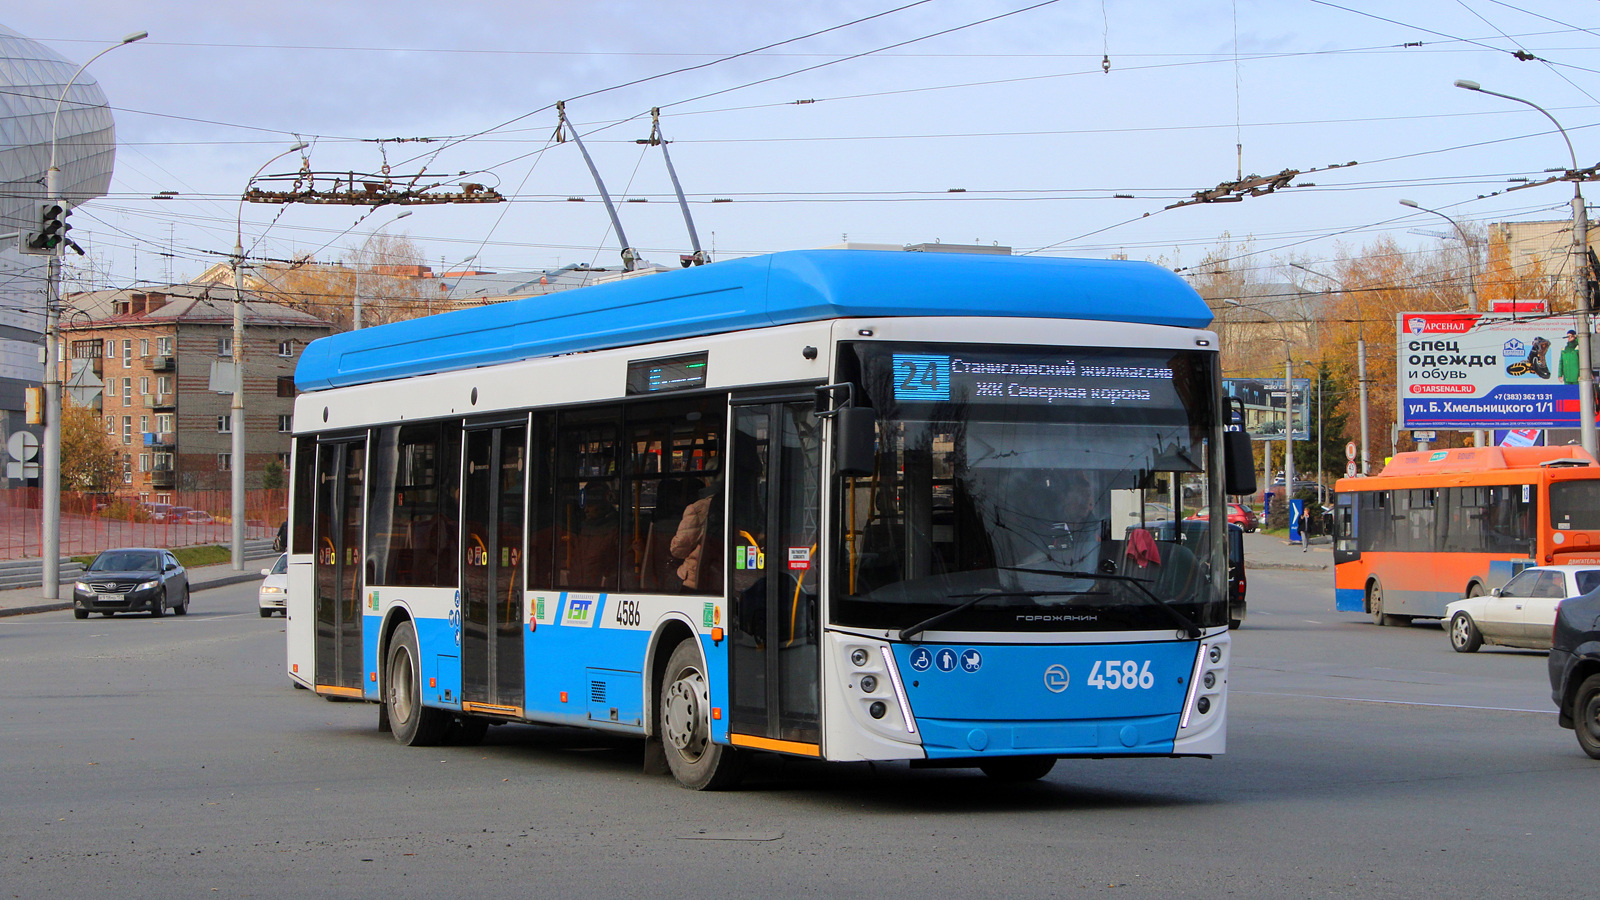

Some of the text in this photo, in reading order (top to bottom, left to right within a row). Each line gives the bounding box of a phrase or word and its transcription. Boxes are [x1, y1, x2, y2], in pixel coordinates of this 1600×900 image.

[1408, 341, 1459, 353] спец
[1408, 355, 1496, 367] одежда
[951, 359, 1173, 379] Станиславский жилмассив
[1422, 368, 1467, 380] обувь
[900, 361, 940, 391] 24
[976, 382, 1151, 405] ЖК Северная корона
[1503, 393, 1522, 401] (383)
[1409, 402, 1553, 415] ул. Б. Хмельницкого 1/1
[1568, 559, 1596, 568] ДВИГАТЕЛЬ
[616, 600, 641, 627] 4586
[1087, 660, 1155, 690] 4586
